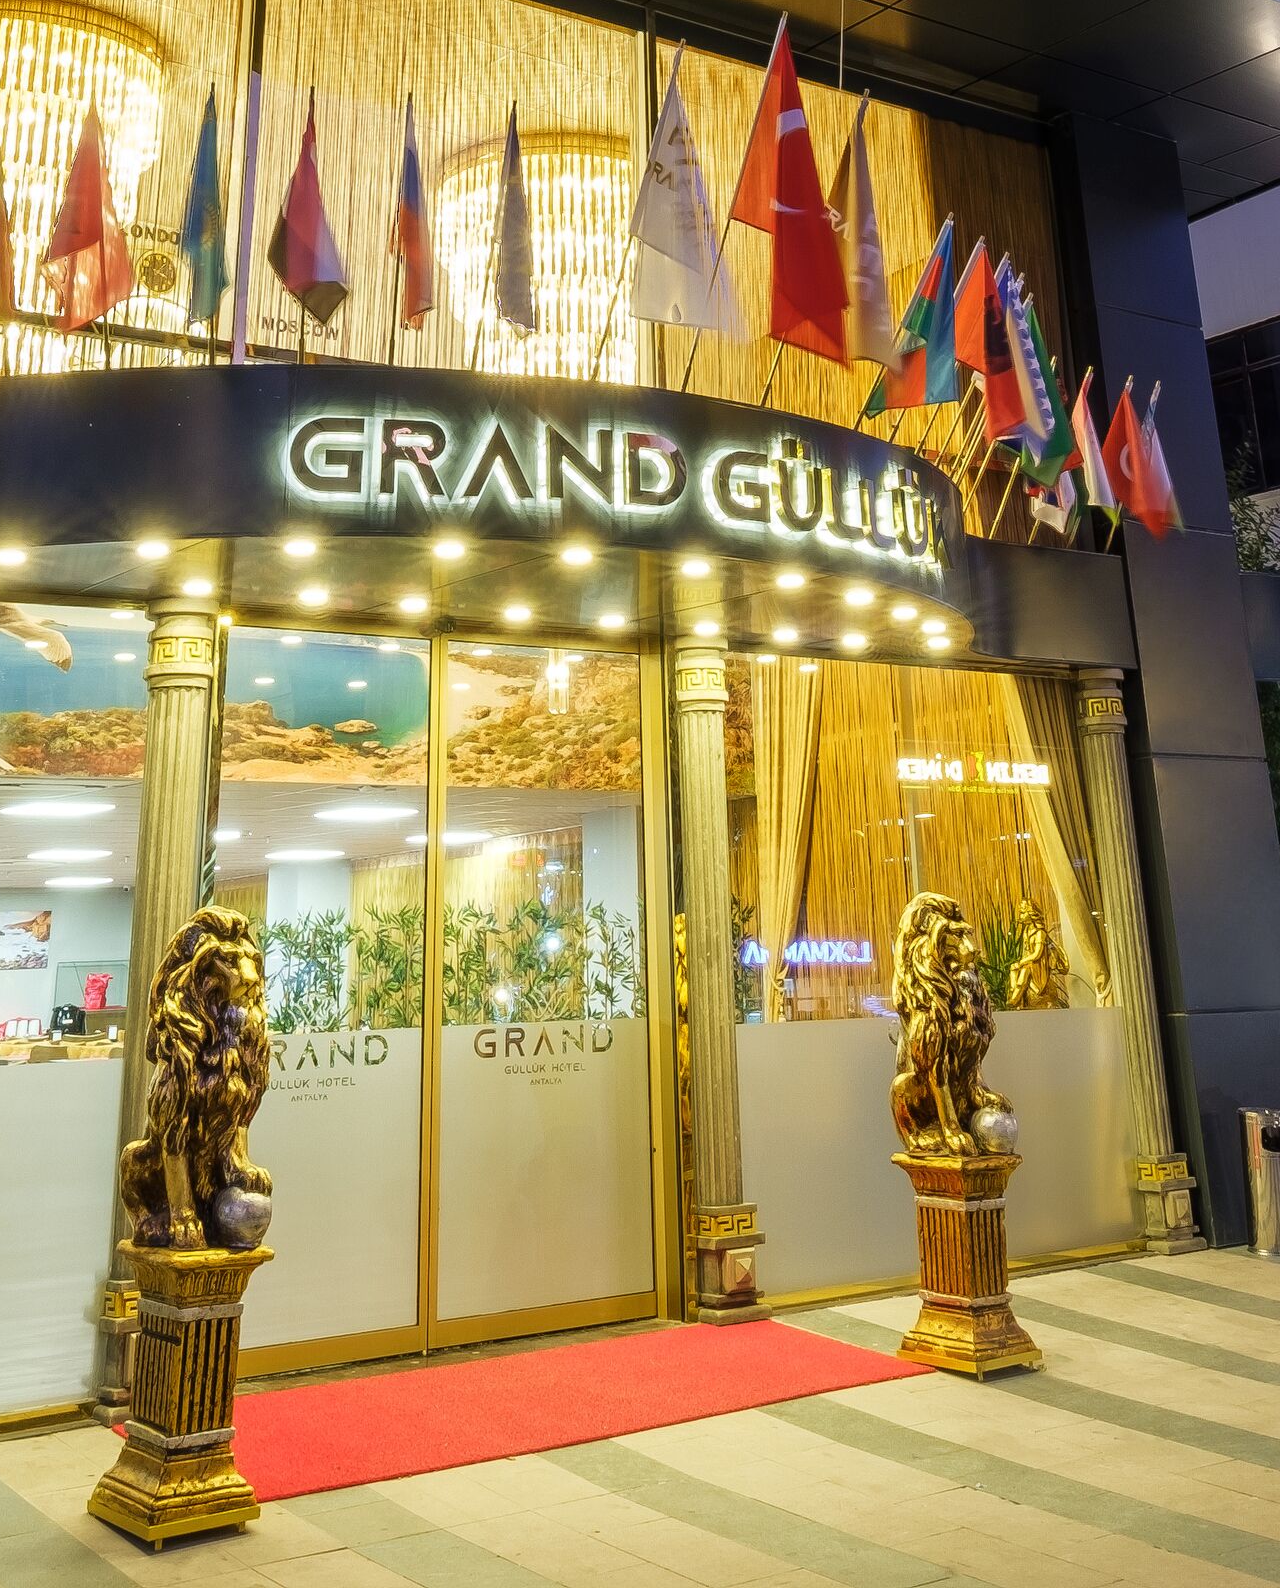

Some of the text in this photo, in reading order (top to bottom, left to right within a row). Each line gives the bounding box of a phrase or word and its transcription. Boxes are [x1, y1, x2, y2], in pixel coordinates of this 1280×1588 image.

[122, 223, 180, 245] ONDO
[261, 315, 340, 341] MOSCOW
[290, 416, 688, 507] GRAND
[473, 1022, 614, 1059] GRAND
[270, 1034, 389, 1072] RAND
[504, 1062, 587, 1076] GÜLLÜK HOTEL
[317, 1076, 356, 1088] HOTEL
[529, 1077, 562, 1086] ANTALYA
[291, 1093, 329, 1102] ANTALYA
